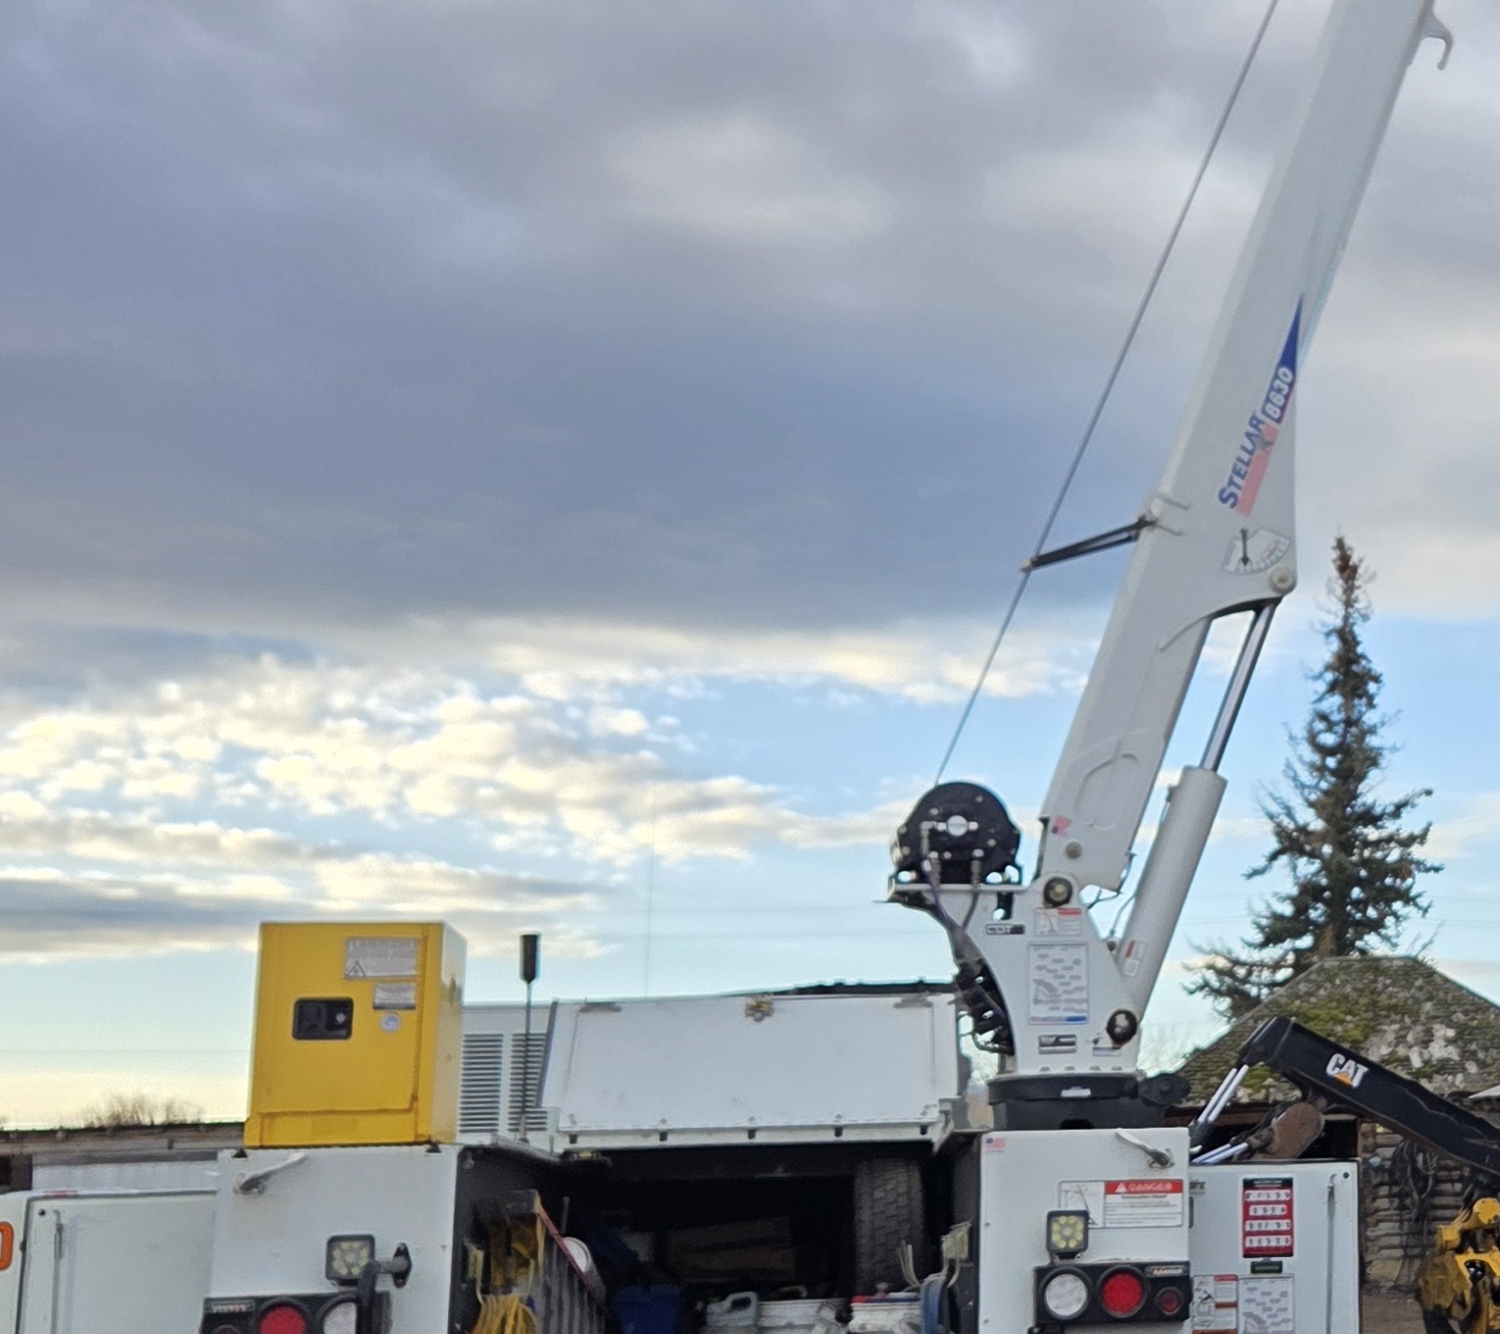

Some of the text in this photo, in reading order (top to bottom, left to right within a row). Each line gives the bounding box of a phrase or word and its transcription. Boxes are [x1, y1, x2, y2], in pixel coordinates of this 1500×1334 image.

[1217, 366, 1294, 509] STELLAR 8630
[1326, 1052, 1369, 1087] CAT
